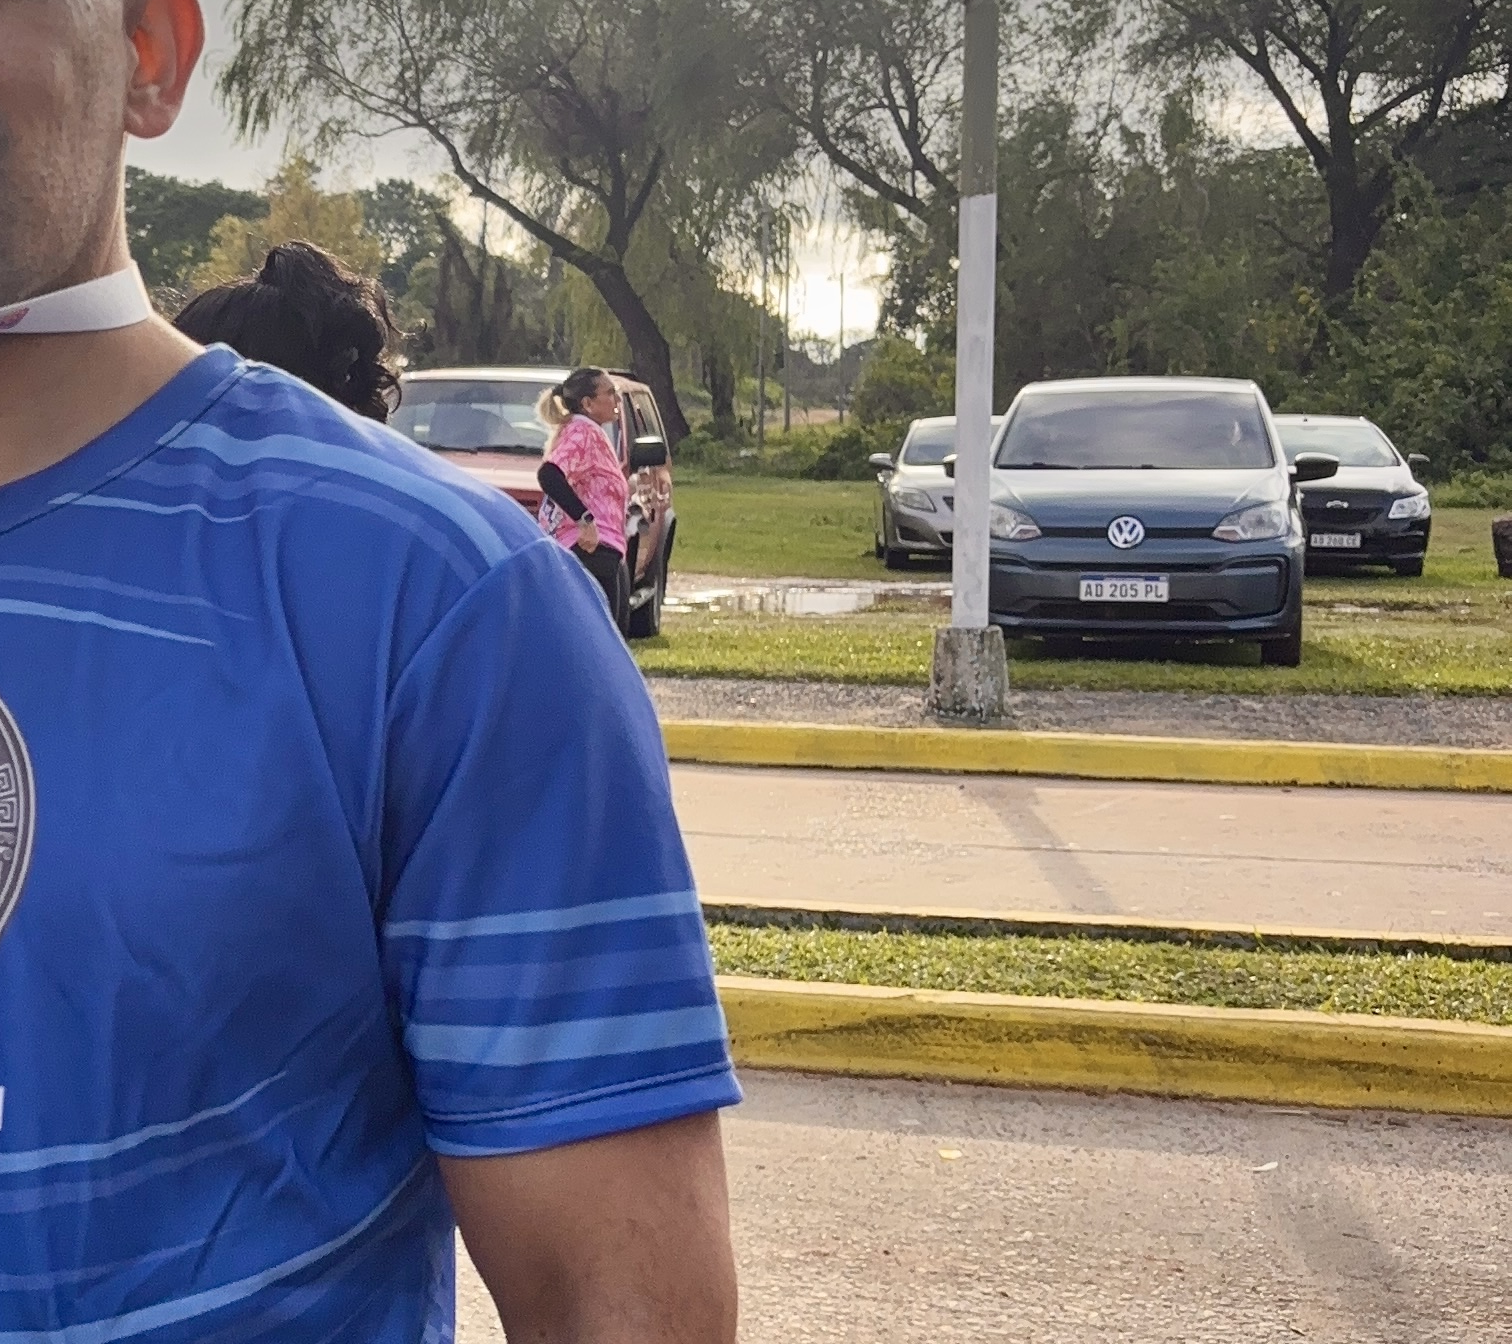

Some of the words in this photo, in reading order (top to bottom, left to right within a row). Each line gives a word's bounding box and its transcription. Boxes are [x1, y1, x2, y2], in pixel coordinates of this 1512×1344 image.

[1084, 583, 1104, 598] AD
[1109, 583, 1139, 598] 205
[1145, 583, 1164, 599] PL
